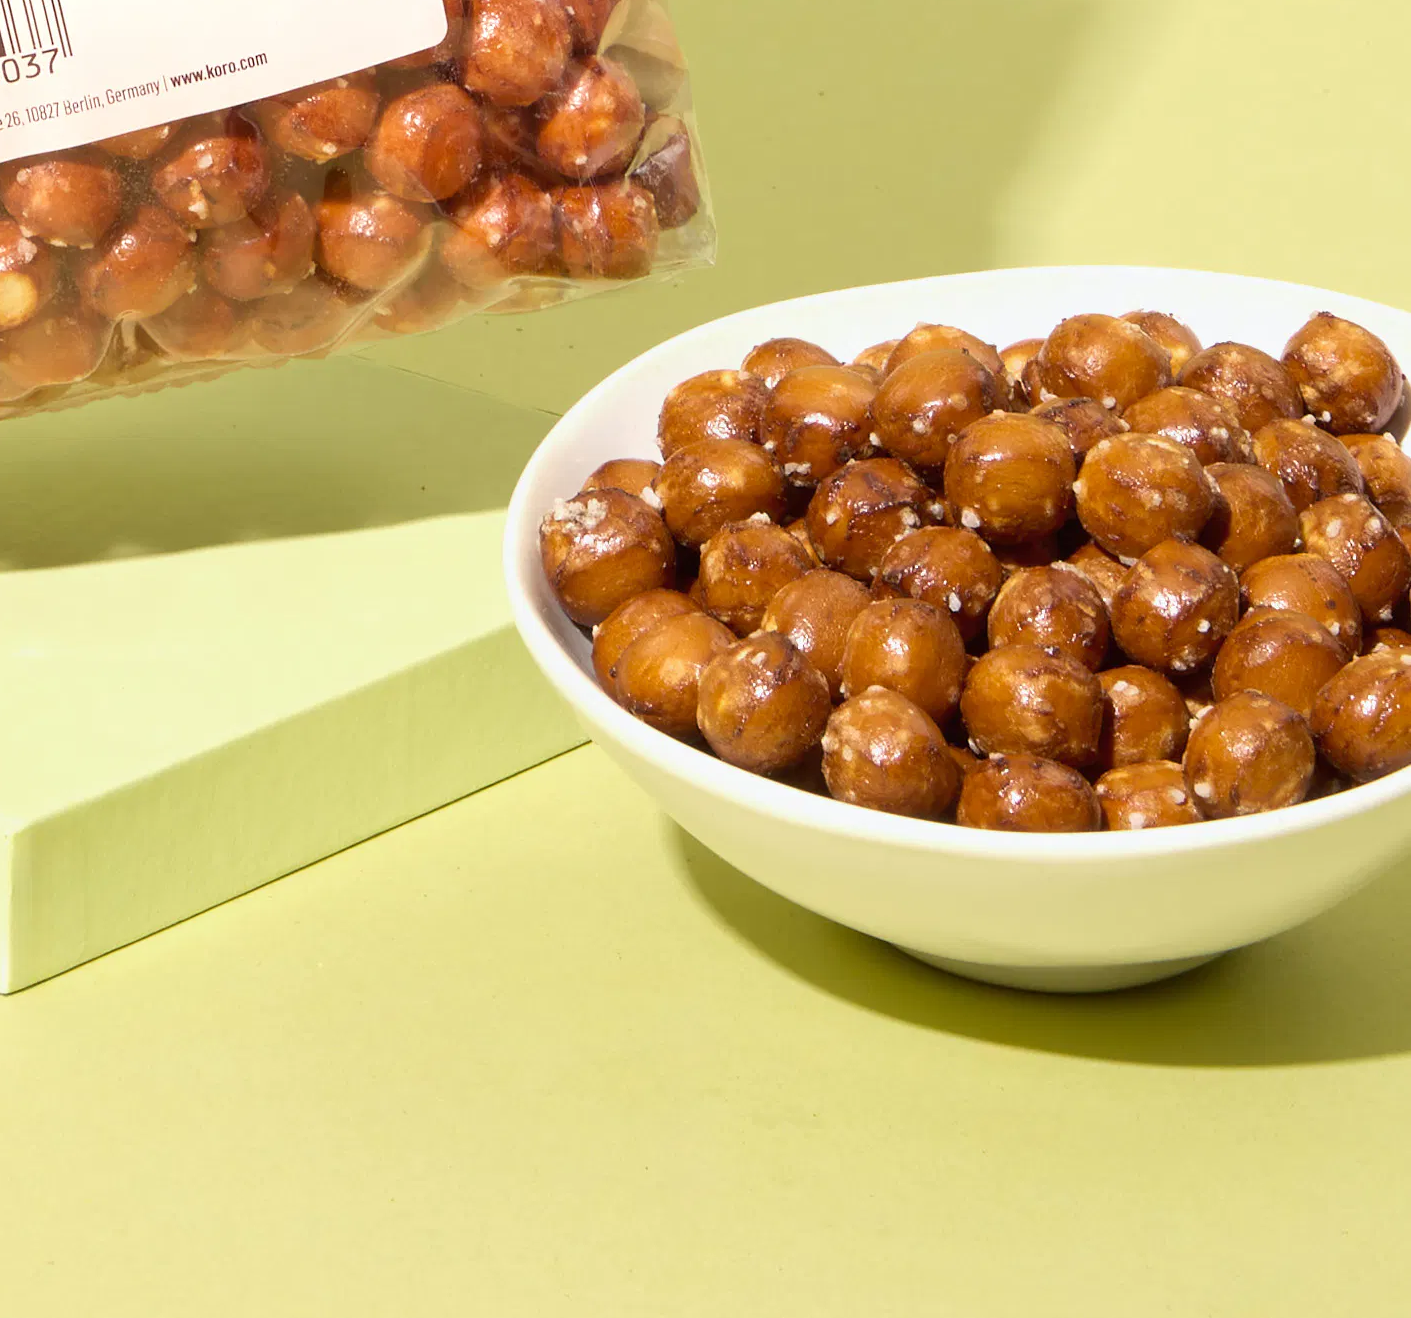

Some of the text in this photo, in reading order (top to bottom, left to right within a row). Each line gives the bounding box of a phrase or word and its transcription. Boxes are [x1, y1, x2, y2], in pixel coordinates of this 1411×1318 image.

[4, 110, 25, 128] 26,
[25, 101, 59, 123] 10827
[62, 94, 105, 116] Berlin,
[105, 80, 160, 105] Germany
[169, 52, 268, 88] www.koro.com
